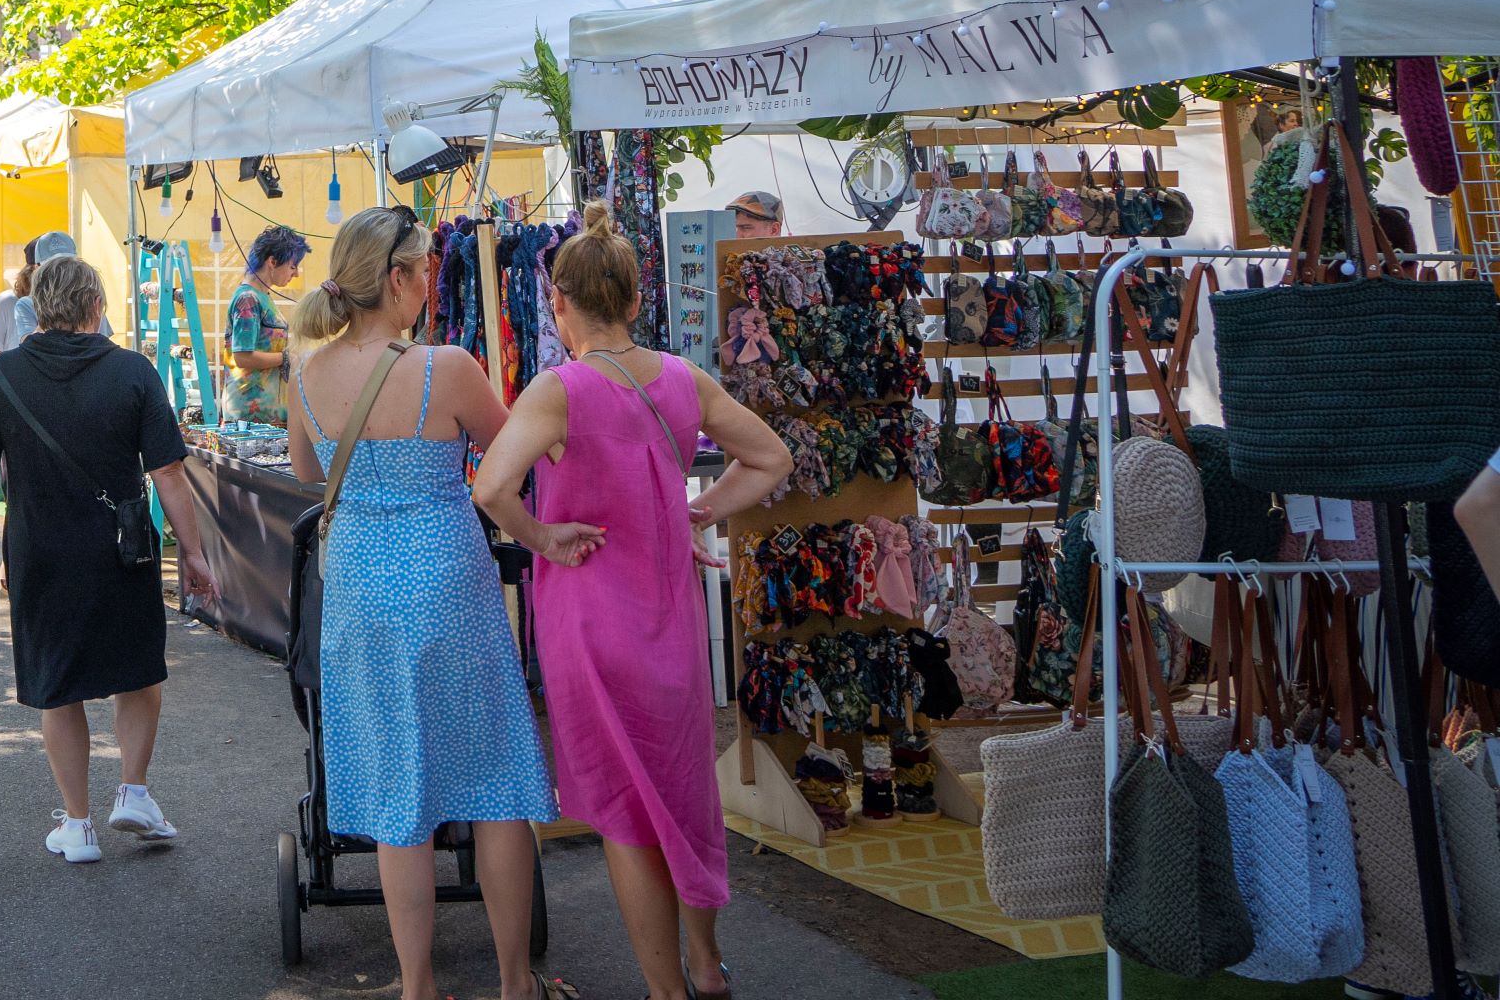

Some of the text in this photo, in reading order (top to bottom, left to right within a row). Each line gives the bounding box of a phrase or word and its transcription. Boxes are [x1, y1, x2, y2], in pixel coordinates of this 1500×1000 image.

[639, 5, 1115, 112] BOHOMAZY by MALWA
[644, 96, 812, 119] Wyprodukowane w Szczecinie
